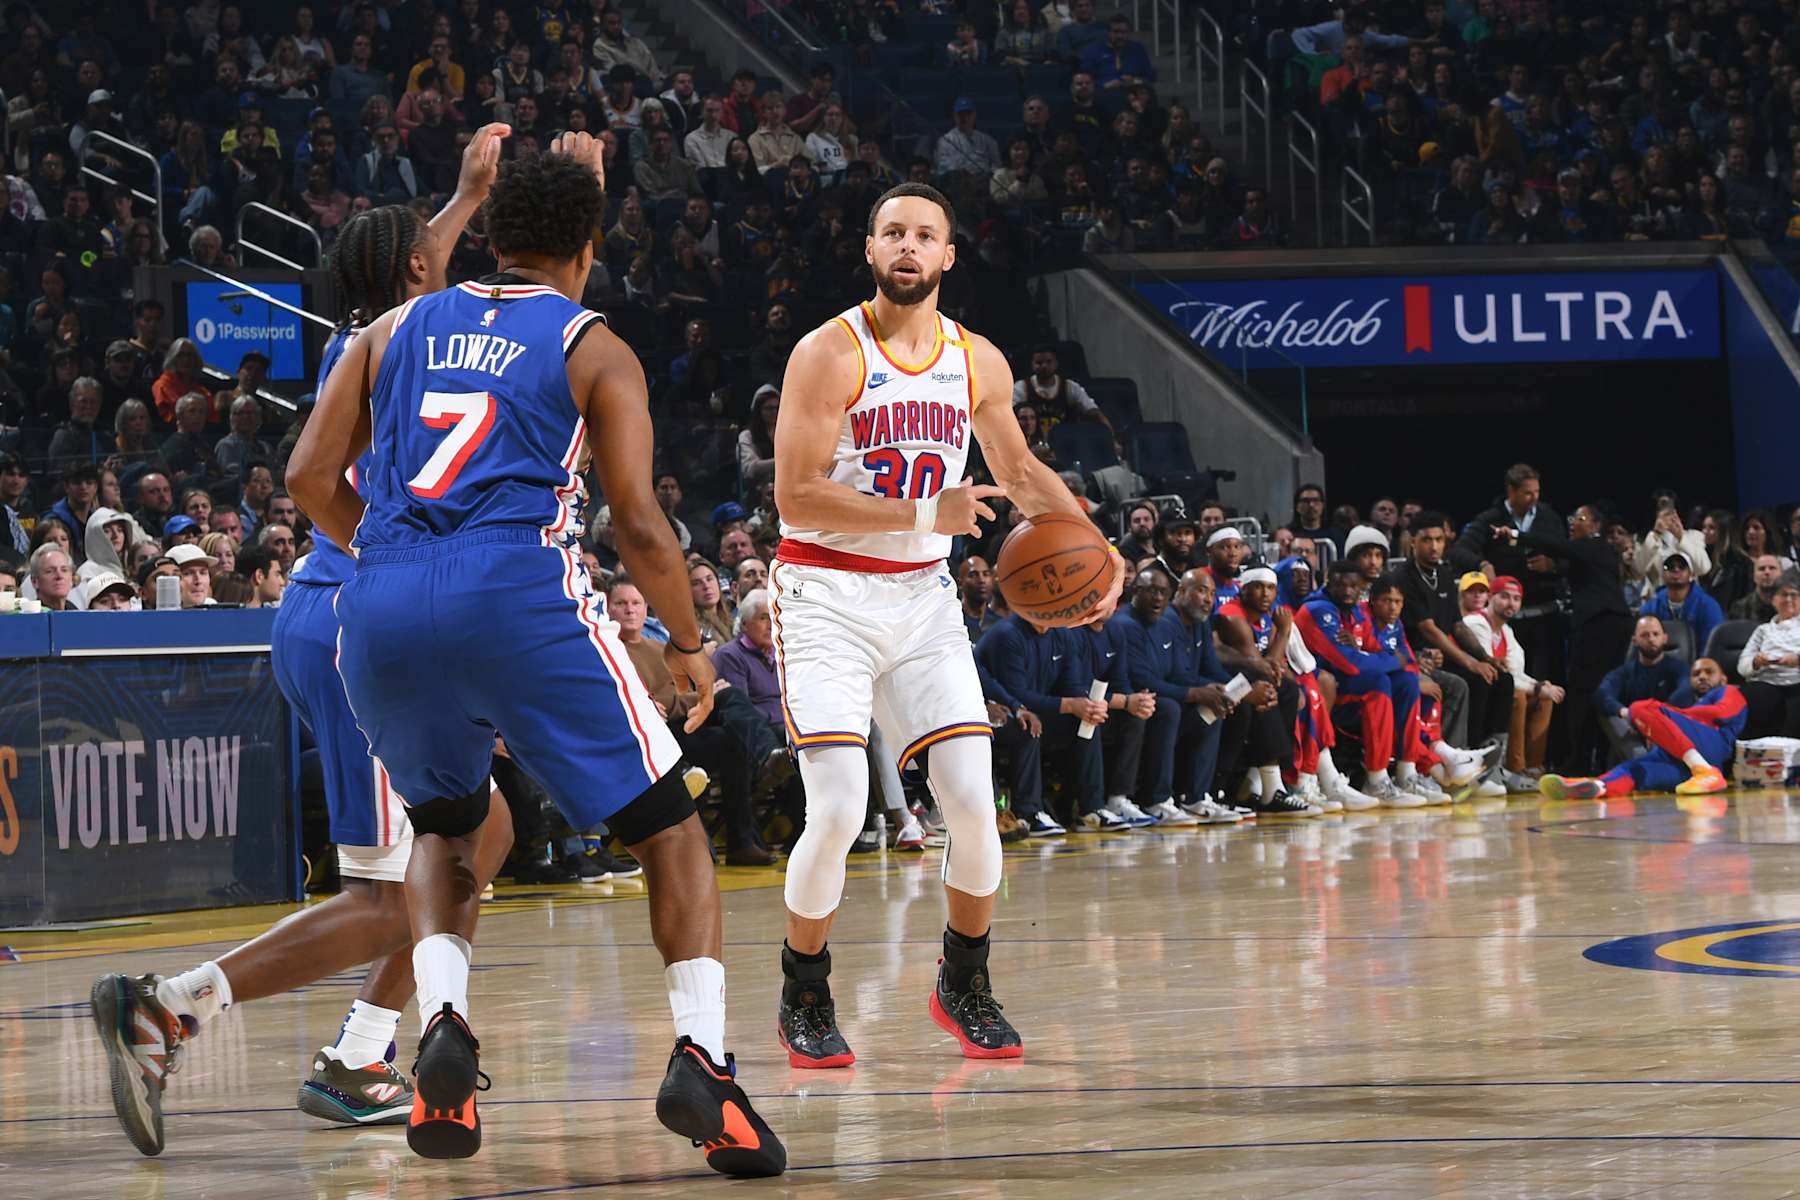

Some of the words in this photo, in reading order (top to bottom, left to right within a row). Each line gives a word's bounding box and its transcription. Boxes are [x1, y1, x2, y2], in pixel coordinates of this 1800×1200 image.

[216, 322, 296, 340] 1Password
[1169, 298, 1390, 349] Michelob
[1454, 290, 1688, 344] ULTRA
[426, 333, 527, 378] LOWRY
[931, 372, 964, 382] Rakuten
[407, 391, 497, 499] 7
[850, 400, 967, 450] WARRIORS
[862, 447, 948, 500] 30
[48, 740, 148, 850] VOTE
[156, 735, 241, 842] NOW
